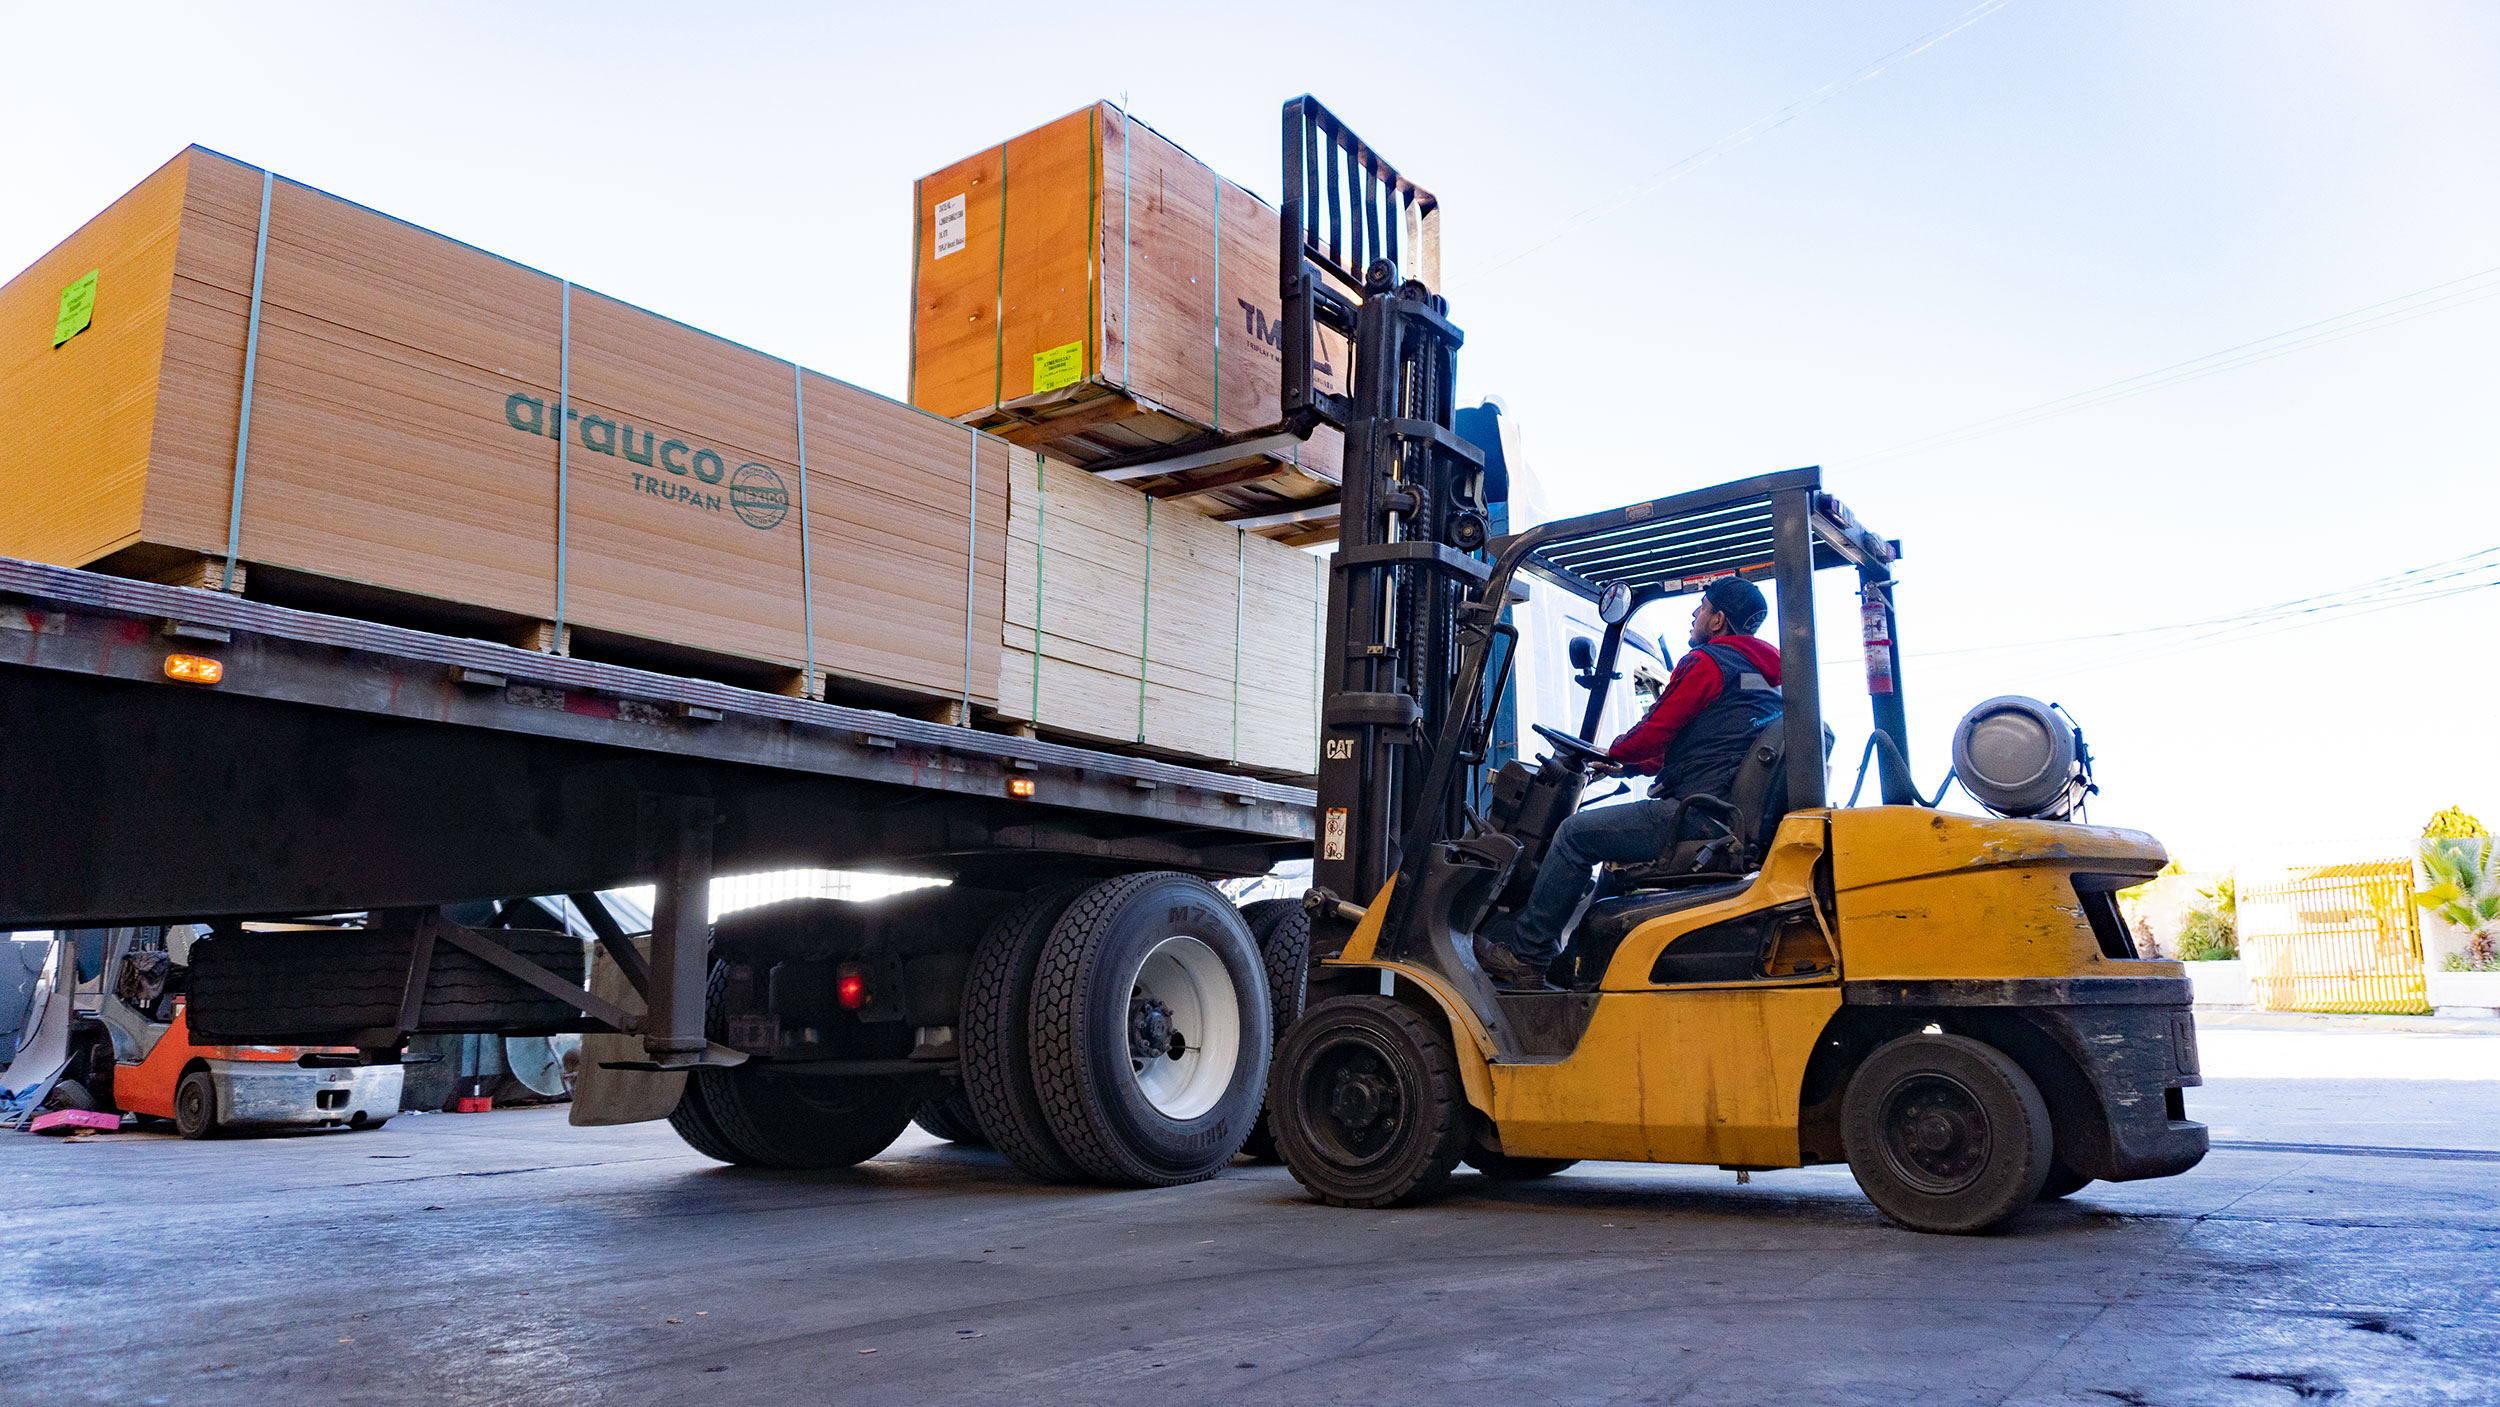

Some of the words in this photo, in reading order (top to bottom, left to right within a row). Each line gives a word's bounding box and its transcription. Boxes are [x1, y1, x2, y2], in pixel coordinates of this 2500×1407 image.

[505, 392, 724, 485] arauco
[632, 472, 721, 513] TRUPAN
[1326, 739, 1354, 759] CAT
